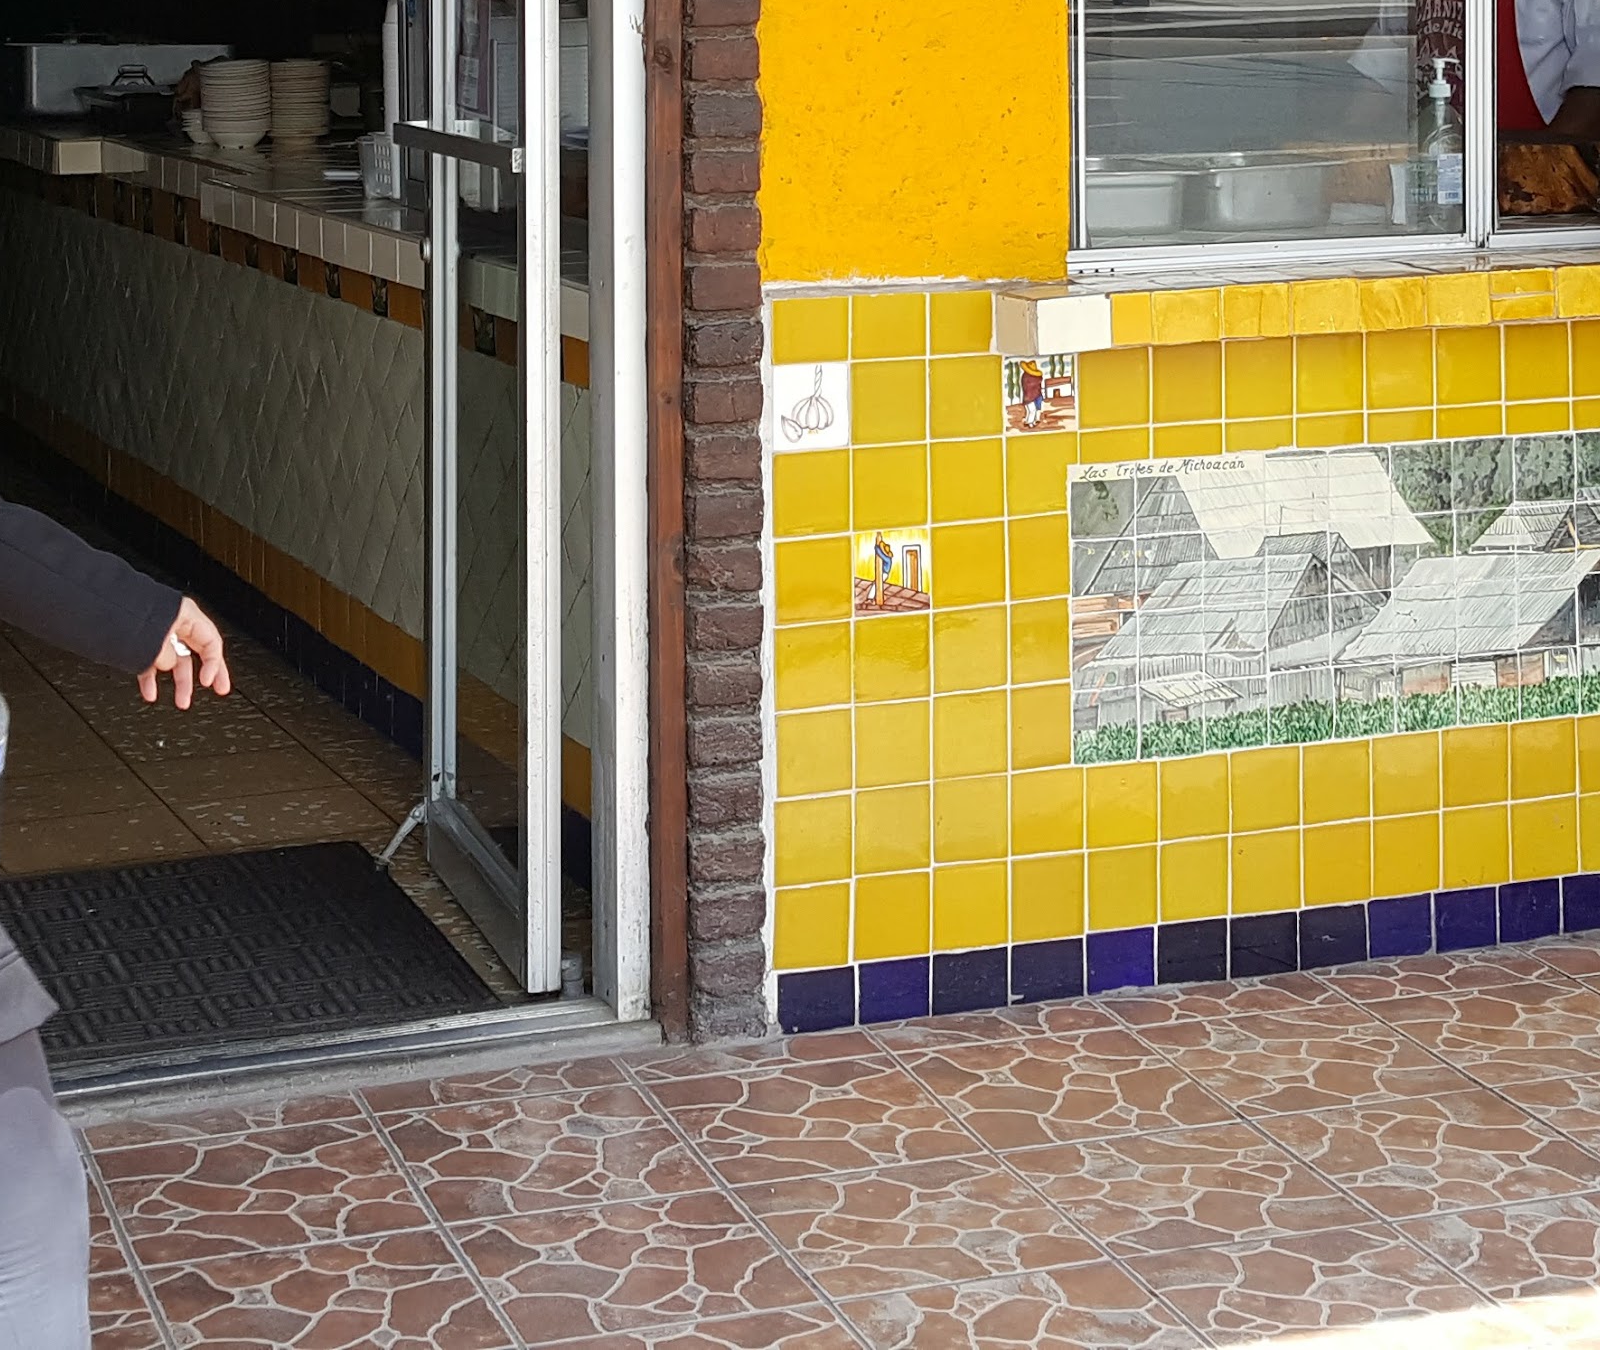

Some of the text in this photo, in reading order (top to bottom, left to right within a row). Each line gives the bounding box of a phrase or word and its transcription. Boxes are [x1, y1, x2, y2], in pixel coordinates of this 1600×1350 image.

[1078, 465, 1108, 480] Las
[1159, 460, 1175, 474] de
[1175, 456, 1246, 475] Michoacán
